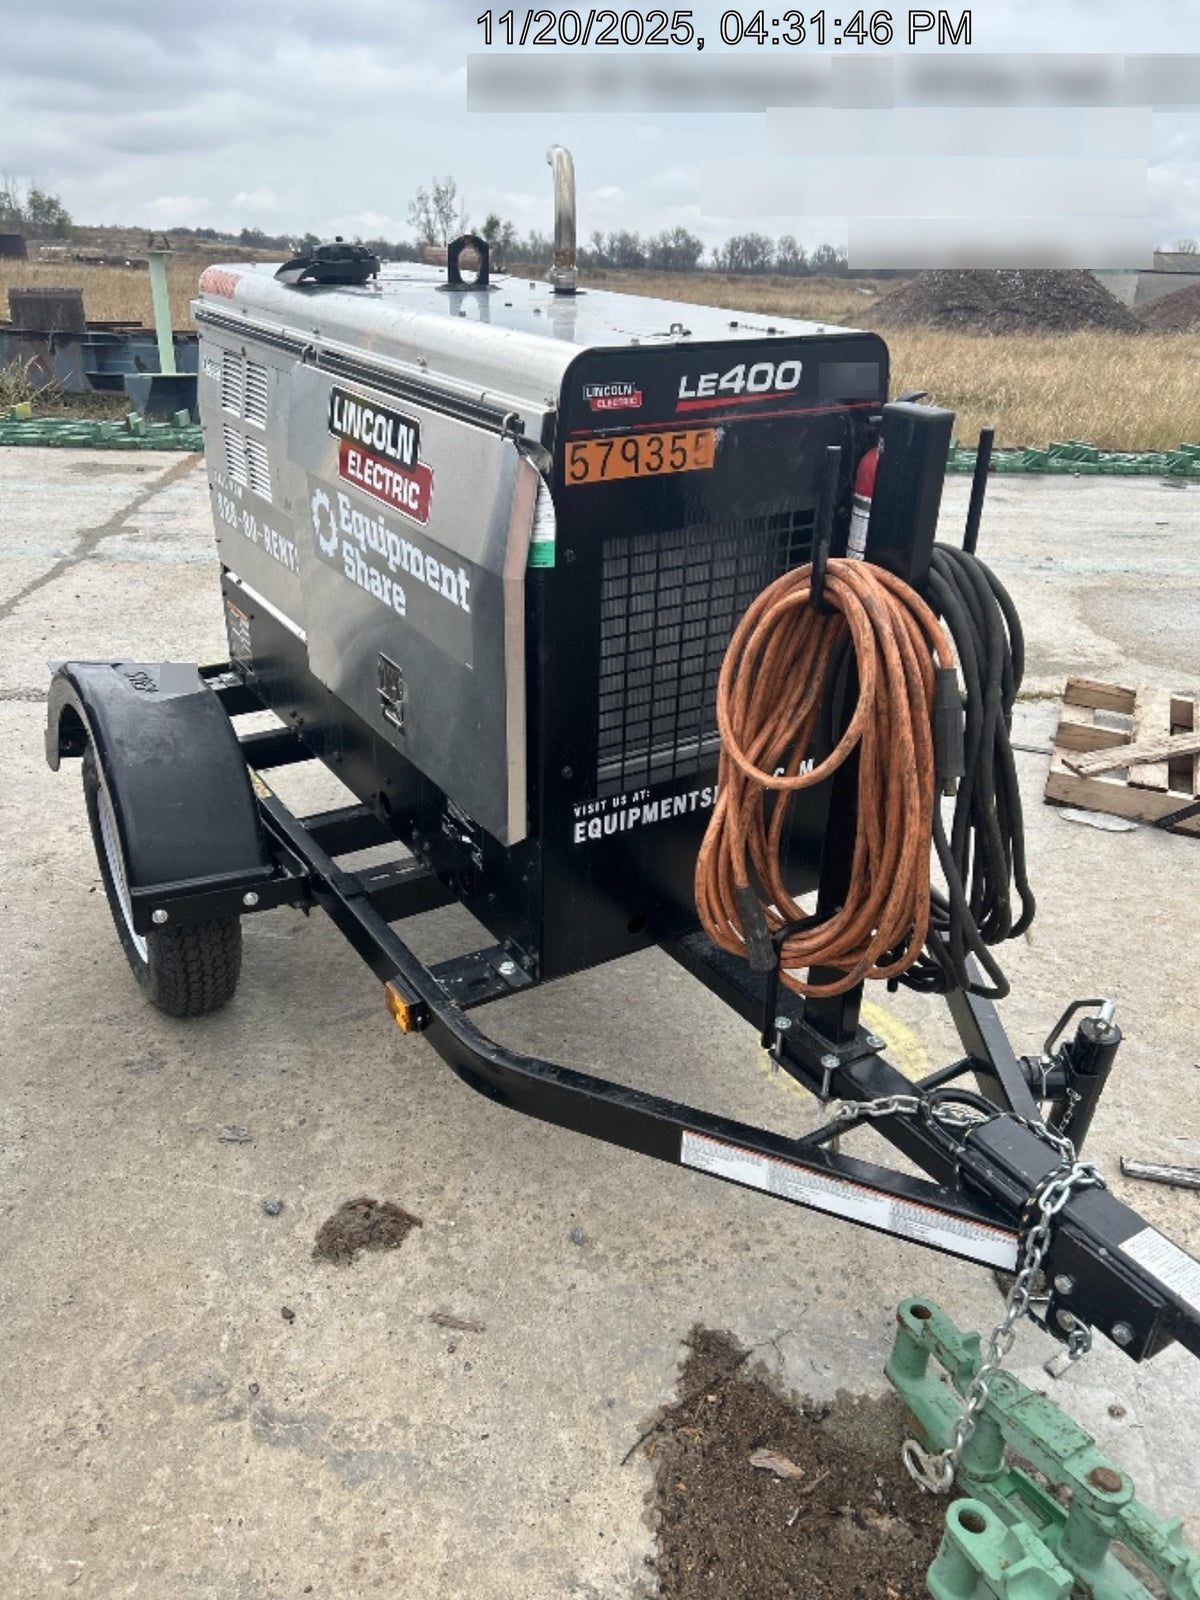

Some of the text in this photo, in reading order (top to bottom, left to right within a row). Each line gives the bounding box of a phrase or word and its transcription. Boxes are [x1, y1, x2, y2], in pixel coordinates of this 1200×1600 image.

[585, 384, 632, 398] LINCOLN
[678, 360, 803, 399] LE400
[333, 393, 414, 466] LINCOLN
[569, 431, 710, 481] 579355
[347, 450, 421, 511] ELECTRIC
[337, 492, 471, 614] Equipment
[342, 544, 406, 617] Share
[573, 790, 650, 817] VISIT US AT:
